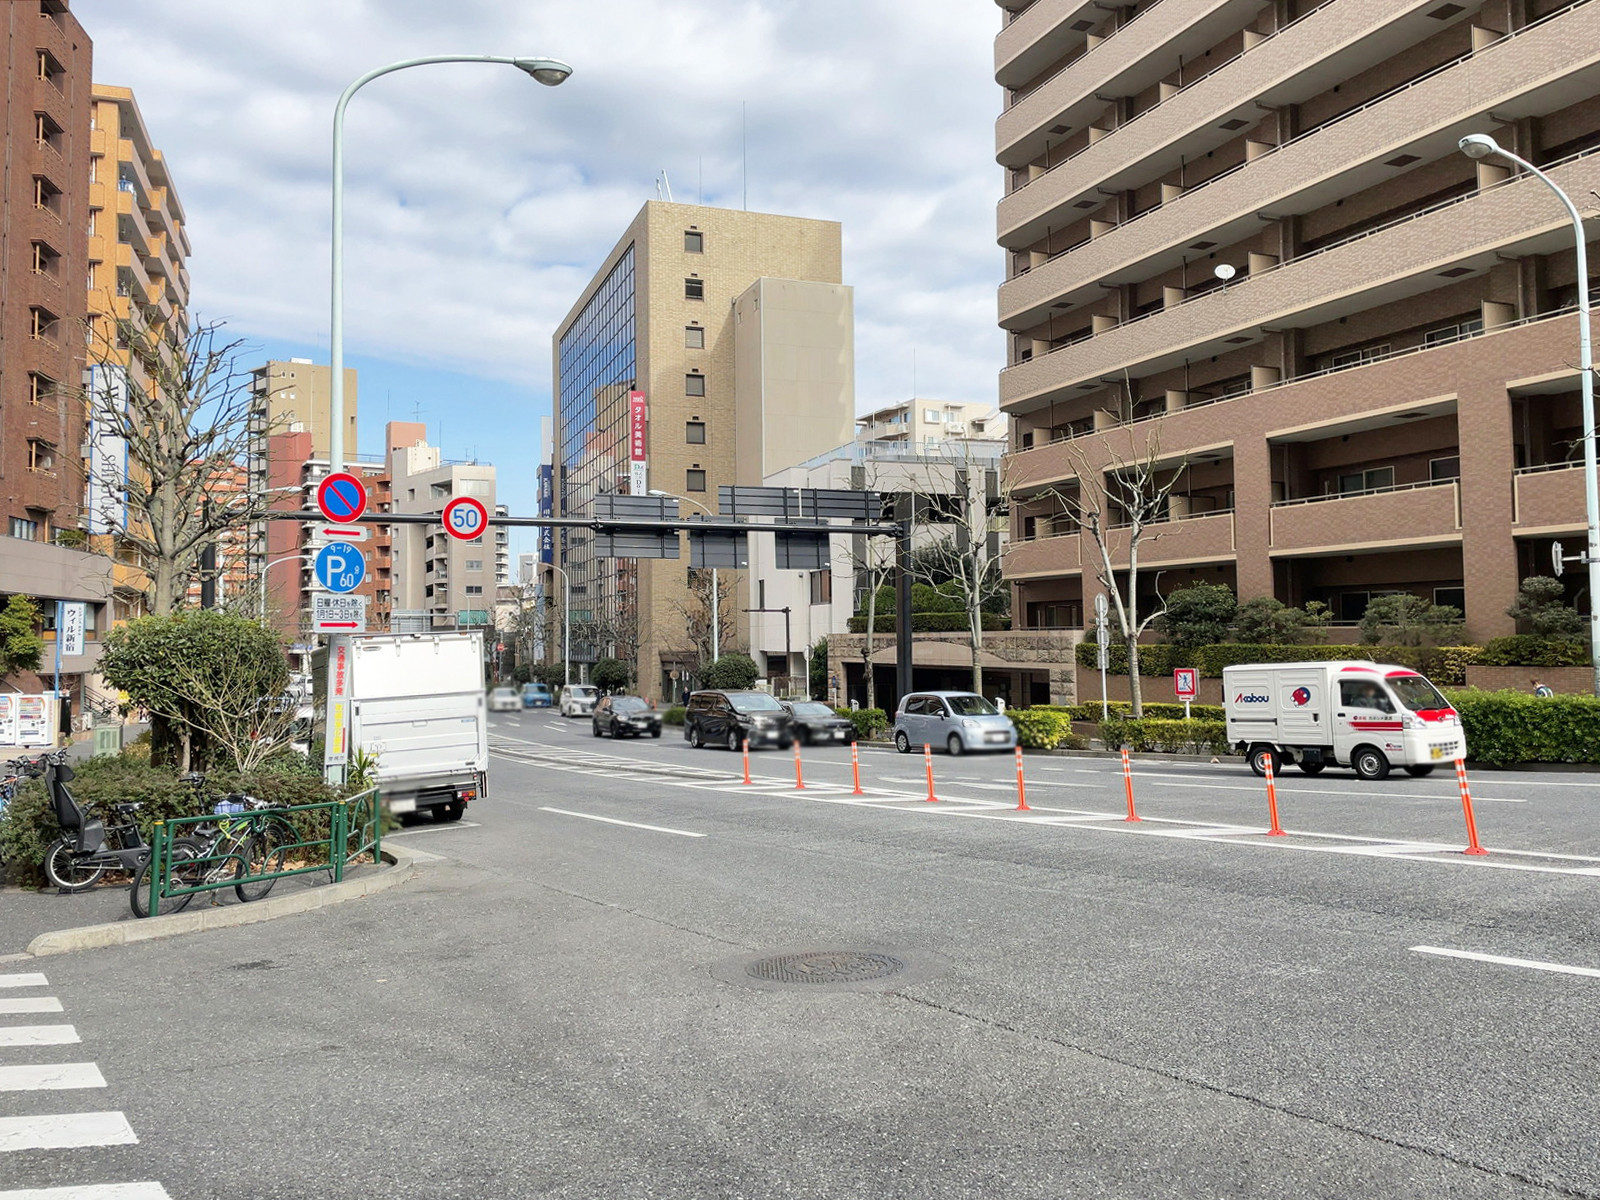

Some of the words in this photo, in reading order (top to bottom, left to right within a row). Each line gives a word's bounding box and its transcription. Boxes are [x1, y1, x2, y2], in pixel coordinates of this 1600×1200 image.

[634, 406, 643, 456] タオル美術館
[453, 508, 478, 528] 50
[330, 544, 352, 554] 9-19
[326, 555, 346, 587] P
[339, 573, 354, 587] 60
[65, 609, 76, 652] ウィル新宿
[1234, 692, 1270, 703] Akabou
